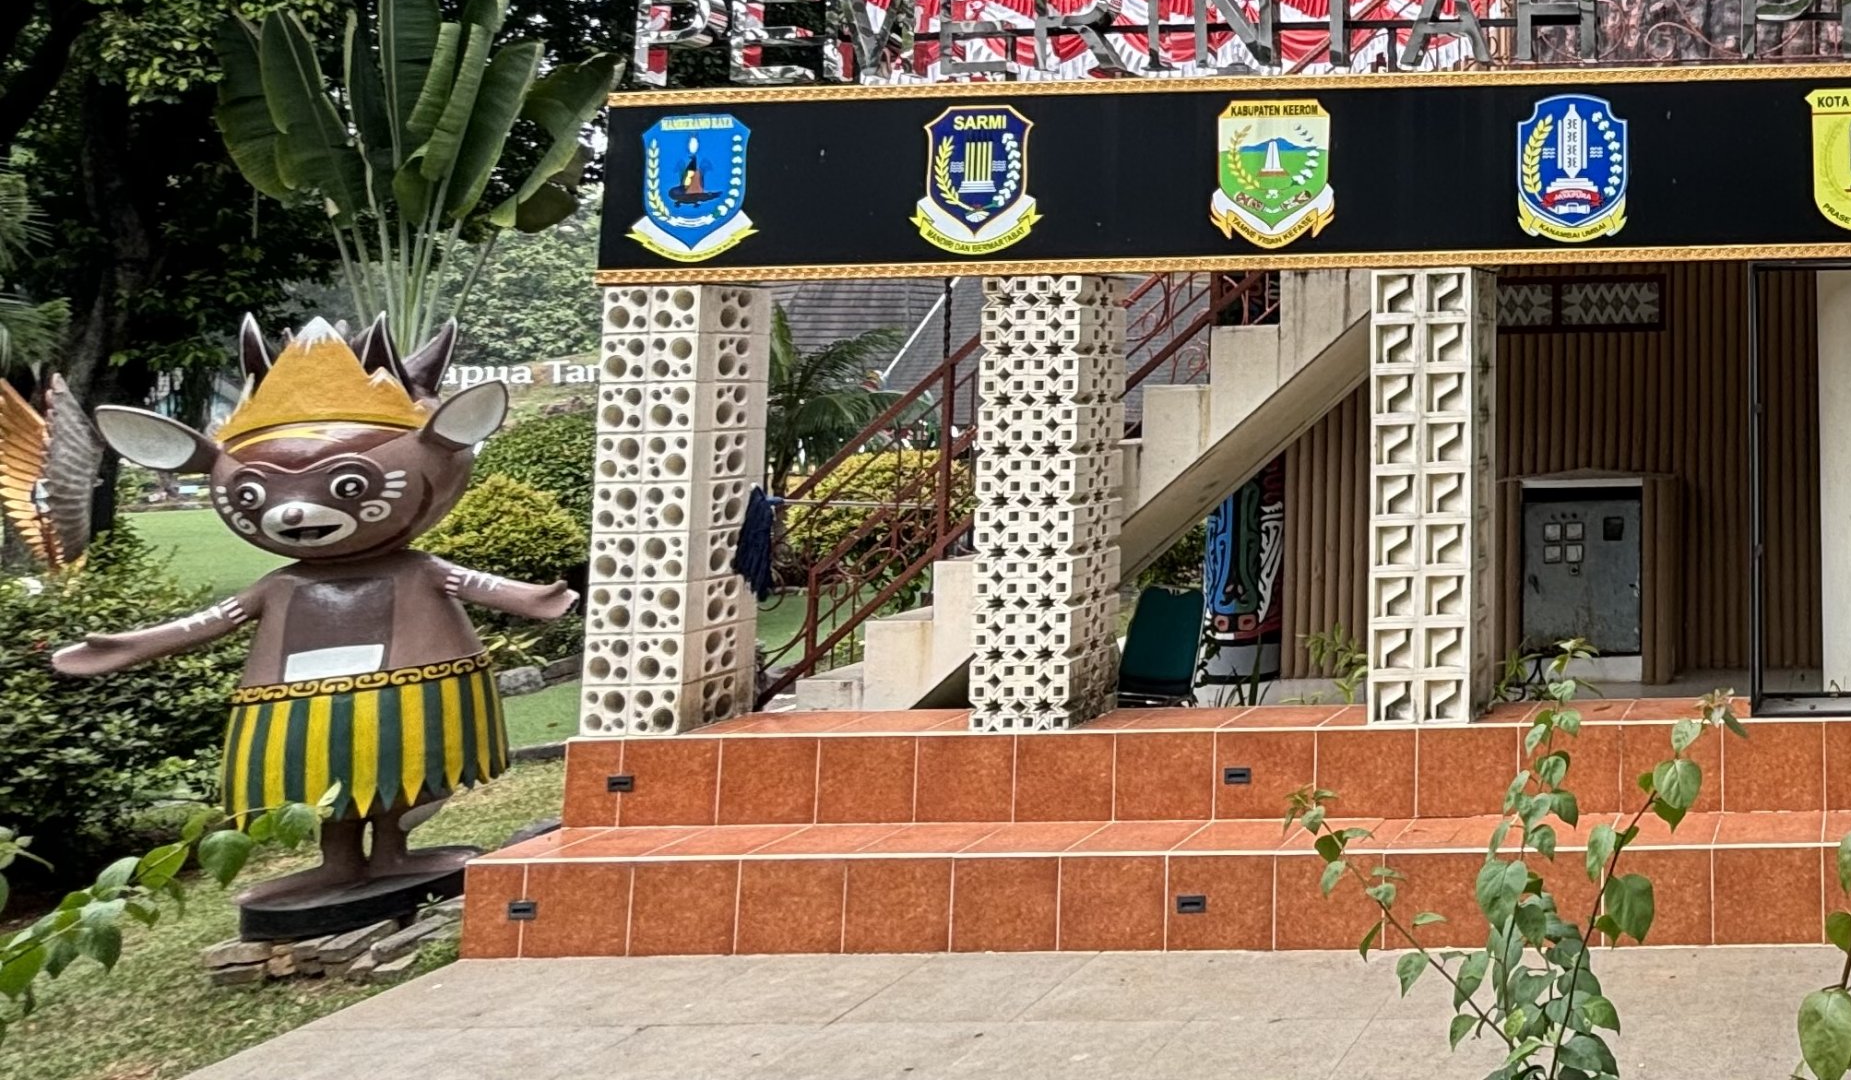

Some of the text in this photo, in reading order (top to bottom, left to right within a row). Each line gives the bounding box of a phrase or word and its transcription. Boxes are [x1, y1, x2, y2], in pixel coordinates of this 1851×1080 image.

[1817, 95, 1849, 108] KOTA
[1231, 104, 1318, 117] KABUPATEN KEEROM
[953, 114, 1007, 131] SARMI
[1232, 216, 1257, 238] TAMNE
[1283, 215, 1313, 241] KEFASE
[955, 244, 970, 252] DAN
[442, 363, 534, 390] apua
